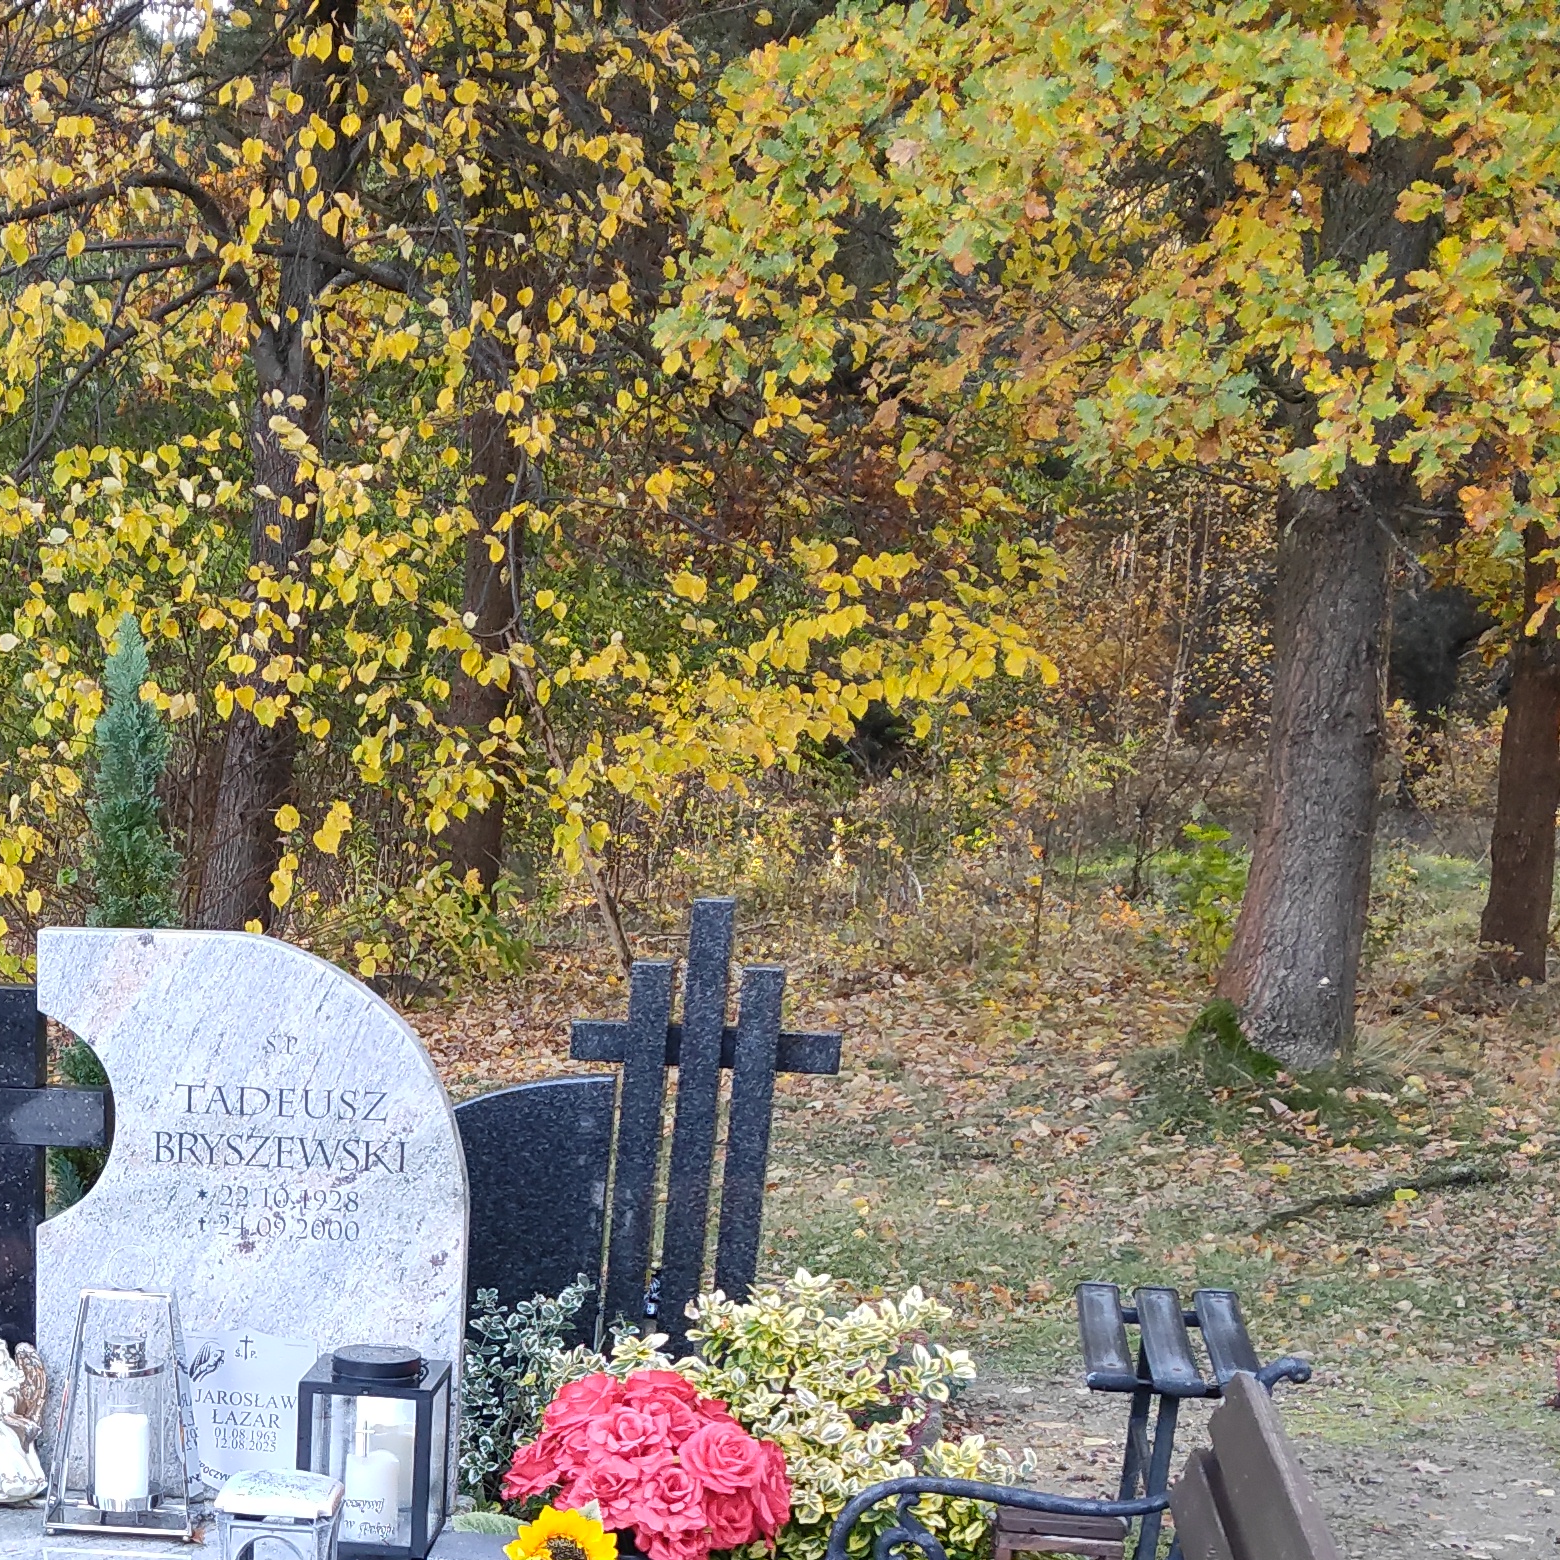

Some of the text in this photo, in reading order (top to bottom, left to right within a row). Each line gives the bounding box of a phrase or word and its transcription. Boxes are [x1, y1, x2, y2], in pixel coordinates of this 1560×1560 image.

[175, 1081, 388, 1124] TADEUSZ
[154, 1131, 409, 1174] BRYSZEWSKI
[194, 1388, 297, 1410] JAROSŁAW
[212, 1408, 281, 1430] ŁAZAR
